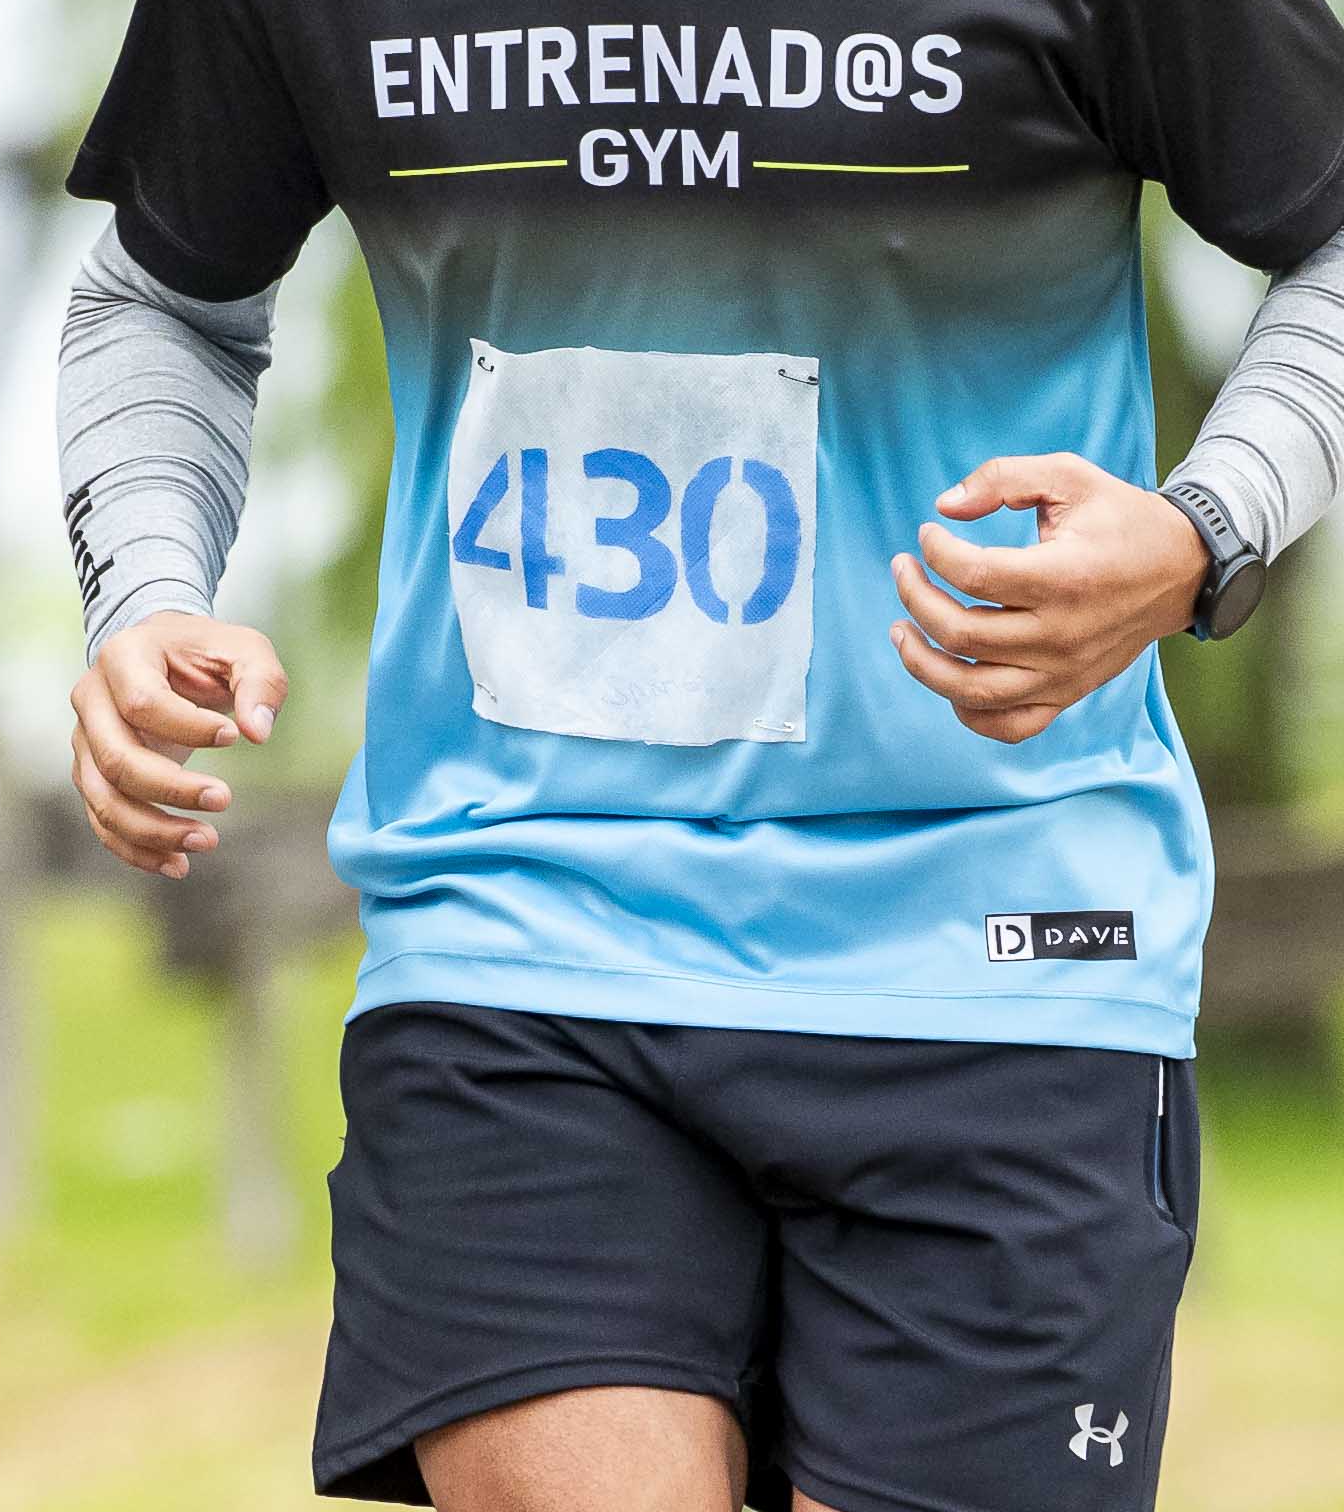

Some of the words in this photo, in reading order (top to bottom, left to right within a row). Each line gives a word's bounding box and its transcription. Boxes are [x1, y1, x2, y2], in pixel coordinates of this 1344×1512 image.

[369, 24, 963, 118] ENTRENAD@S
[578, 128, 740, 188] GYM
[452, 447, 802, 626] 430
[1044, 926, 1129, 946] DAVE
